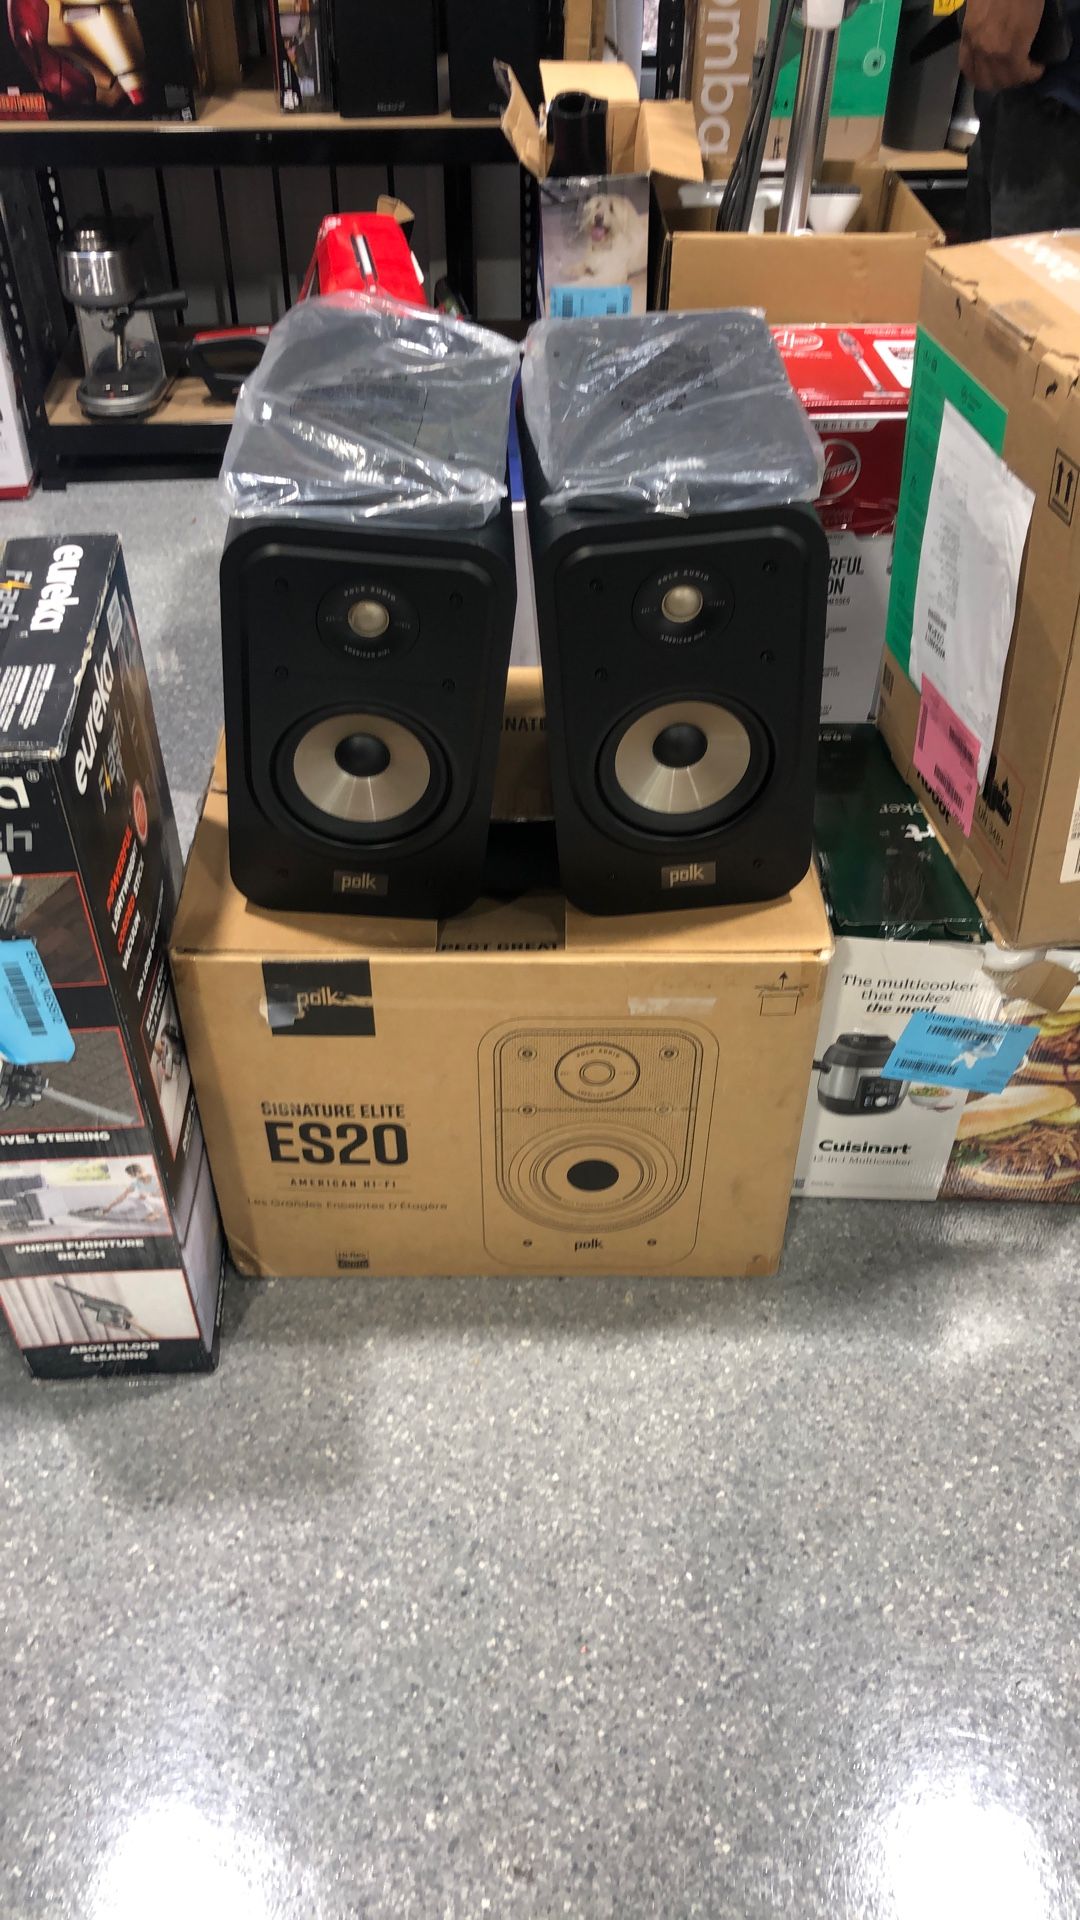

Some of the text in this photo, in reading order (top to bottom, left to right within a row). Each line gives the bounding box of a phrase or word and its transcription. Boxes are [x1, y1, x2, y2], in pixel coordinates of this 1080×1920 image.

[30, 544, 84, 633] eureka
[74, 645, 115, 796] eureka
[669, 864, 705, 884] polk
[340, 873, 377, 892] polk
[841, 974, 978, 992] The multicooker
[861, 988, 951, 1004] that makes
[866, 1002, 895, 1014] the
[261, 1102, 406, 1119] SIGNATURE ELITE
[37, 1131, 111, 1144] STEERING
[265, 1120, 409, 1166] ES20
[818, 1139, 912, 1155] Cuisinart
[290, 1178, 357, 1189] AMERICAN
[15, 1238, 145, 1255] UNDER FURNITURE
[573, 1238, 604, 1253] polk
[57, 1250, 106, 1262] REACH
[70, 1341, 160, 1355] ABOVE FLOOR
[83, 1350, 149, 1363] CLEANING
